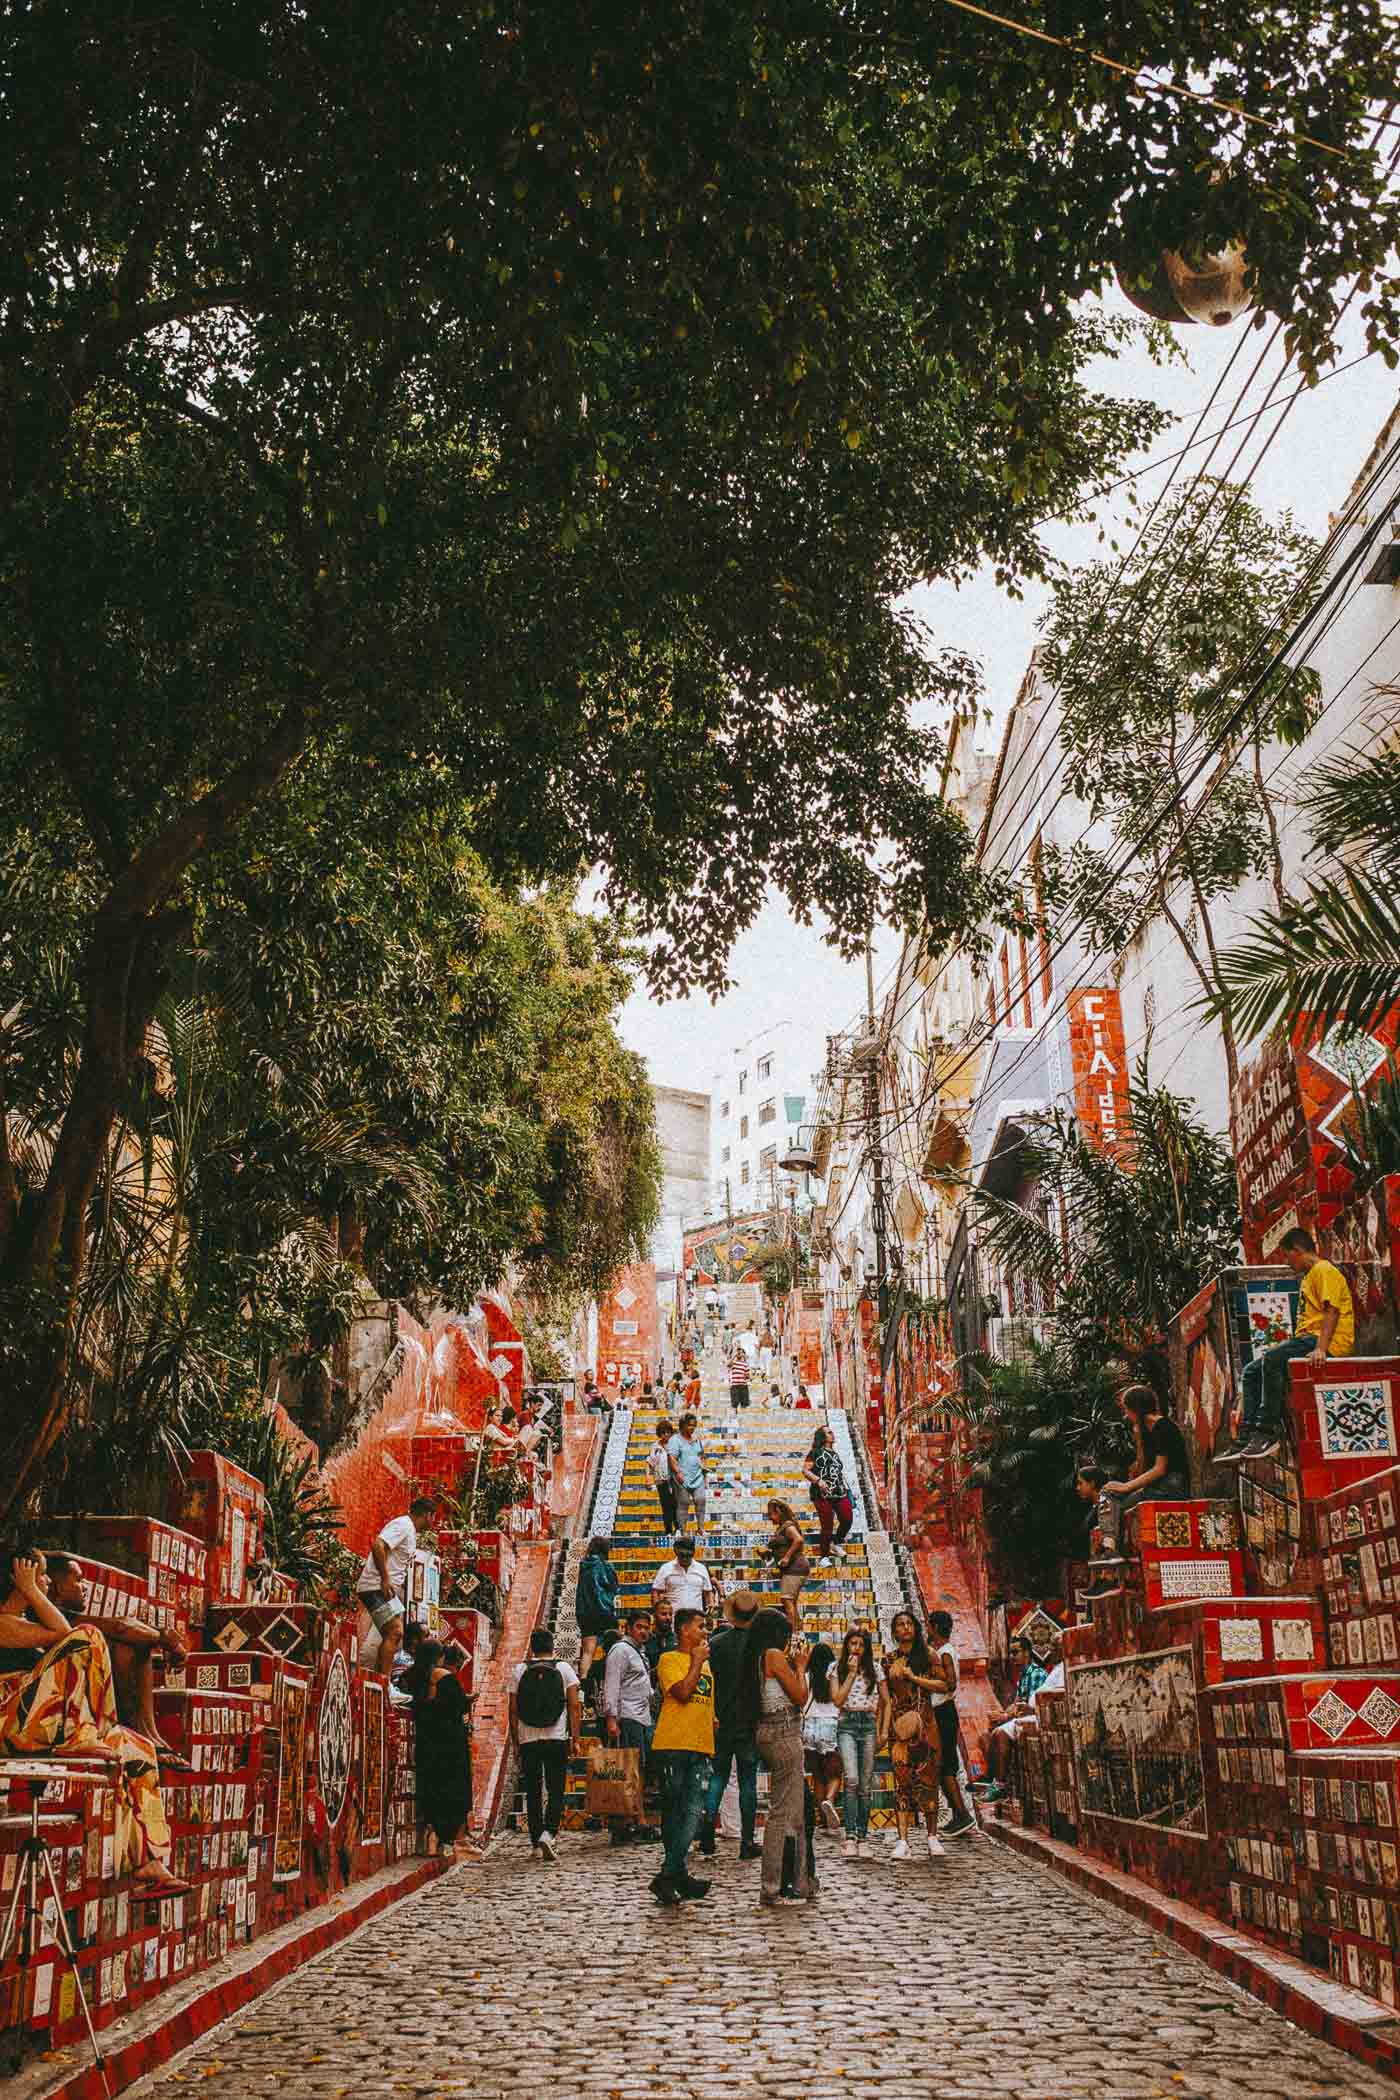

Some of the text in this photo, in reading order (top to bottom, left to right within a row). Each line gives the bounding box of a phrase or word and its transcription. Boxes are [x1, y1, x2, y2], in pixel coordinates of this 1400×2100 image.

[1236, 1068, 1291, 1151] BRASIL
[1255, 1135, 1271, 1162] TE
[1271, 1106, 1295, 1148] AMO
